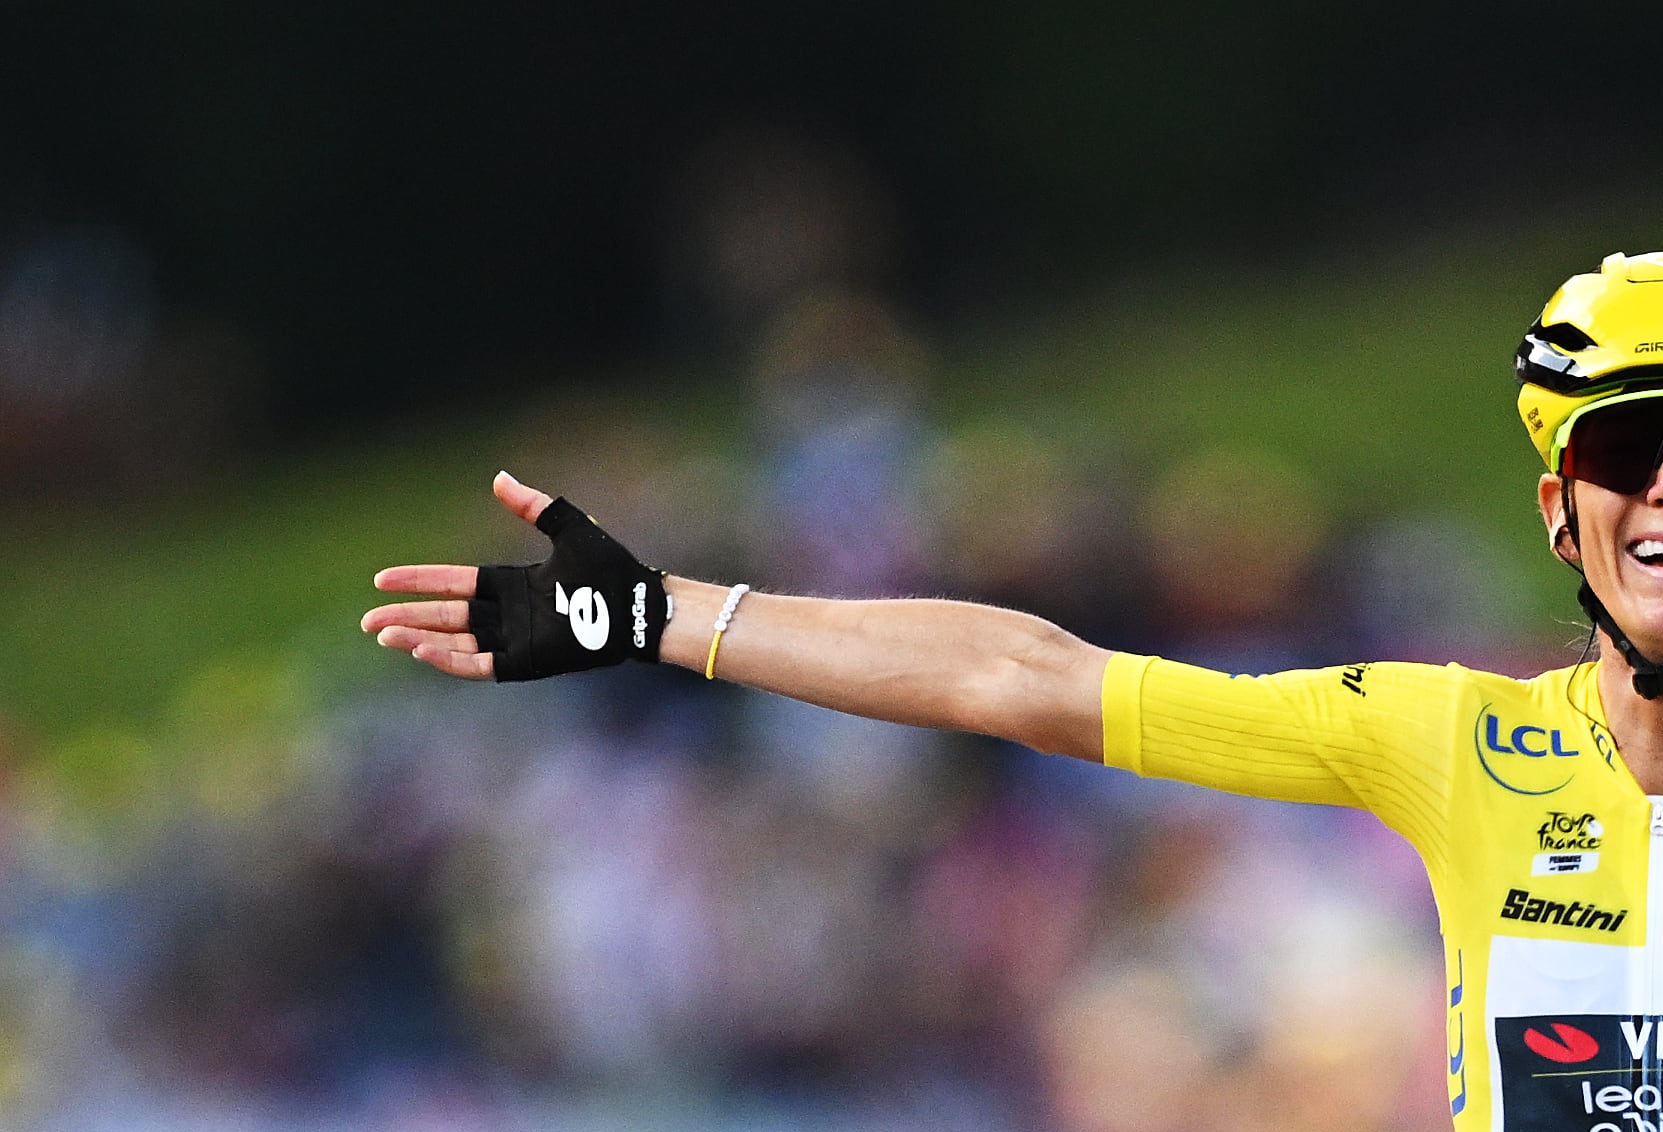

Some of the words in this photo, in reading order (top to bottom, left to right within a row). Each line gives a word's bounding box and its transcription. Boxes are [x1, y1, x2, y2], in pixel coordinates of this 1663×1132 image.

[632, 581, 648, 648] GripGrab
[1486, 714, 1579, 757] LCL
[1500, 888, 1628, 932] Santini
